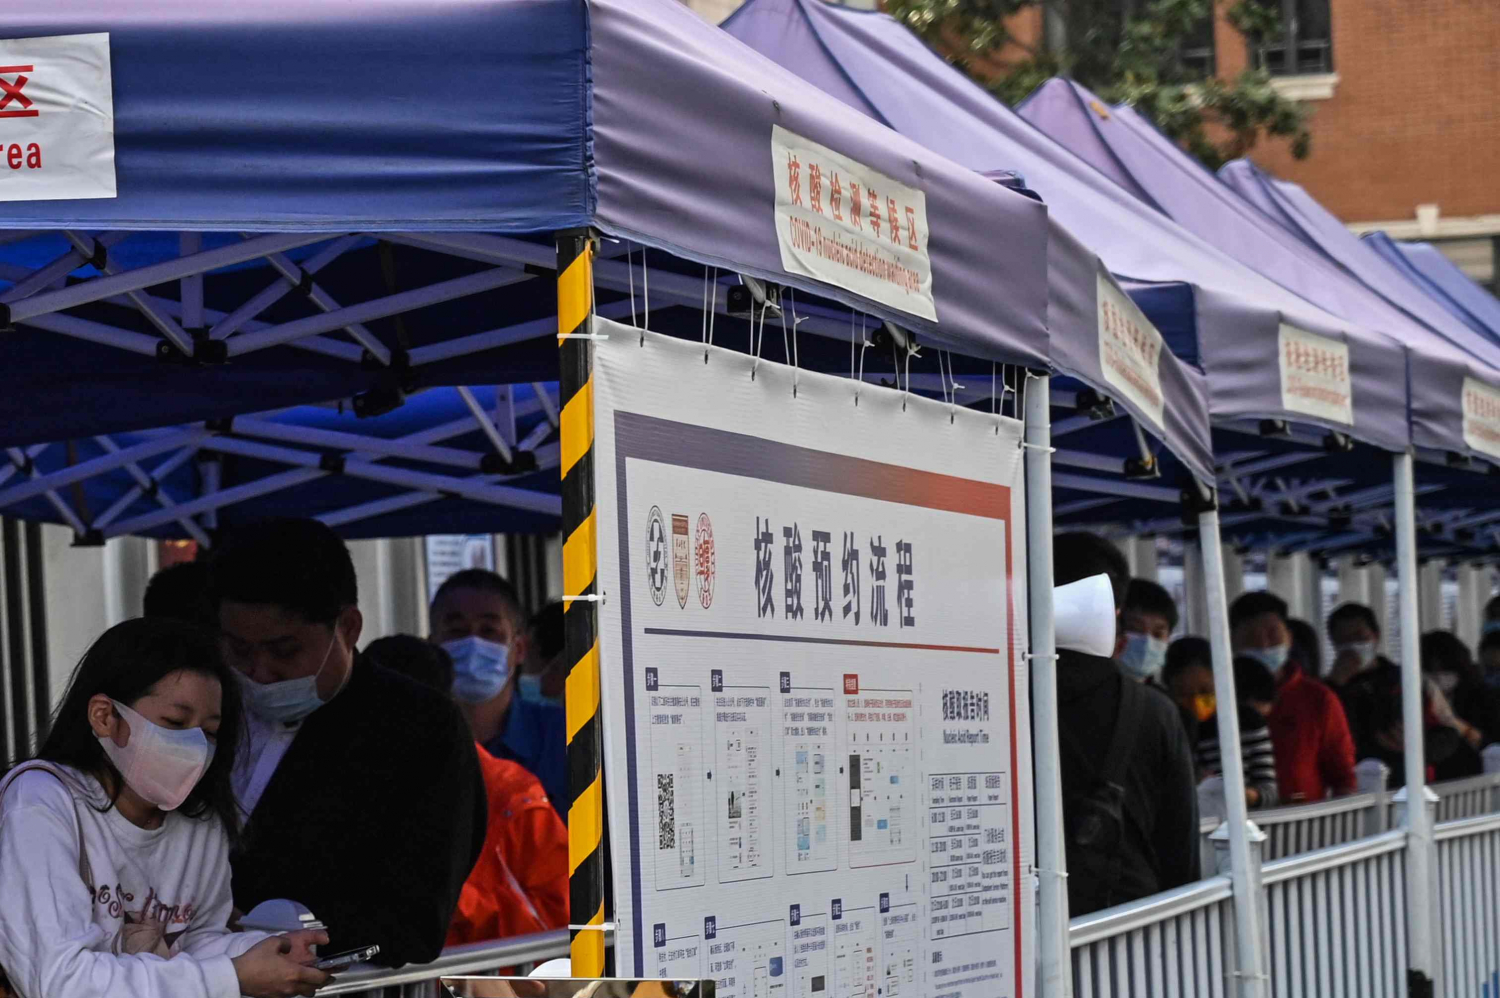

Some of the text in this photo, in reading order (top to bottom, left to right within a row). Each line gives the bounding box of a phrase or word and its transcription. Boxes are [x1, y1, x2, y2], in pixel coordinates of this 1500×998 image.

[787, 152, 919, 251] 核酸检测等候区
[753, 515, 916, 629] 核酸预约流程
[942, 690, 990, 722] 核酸取报告时间
